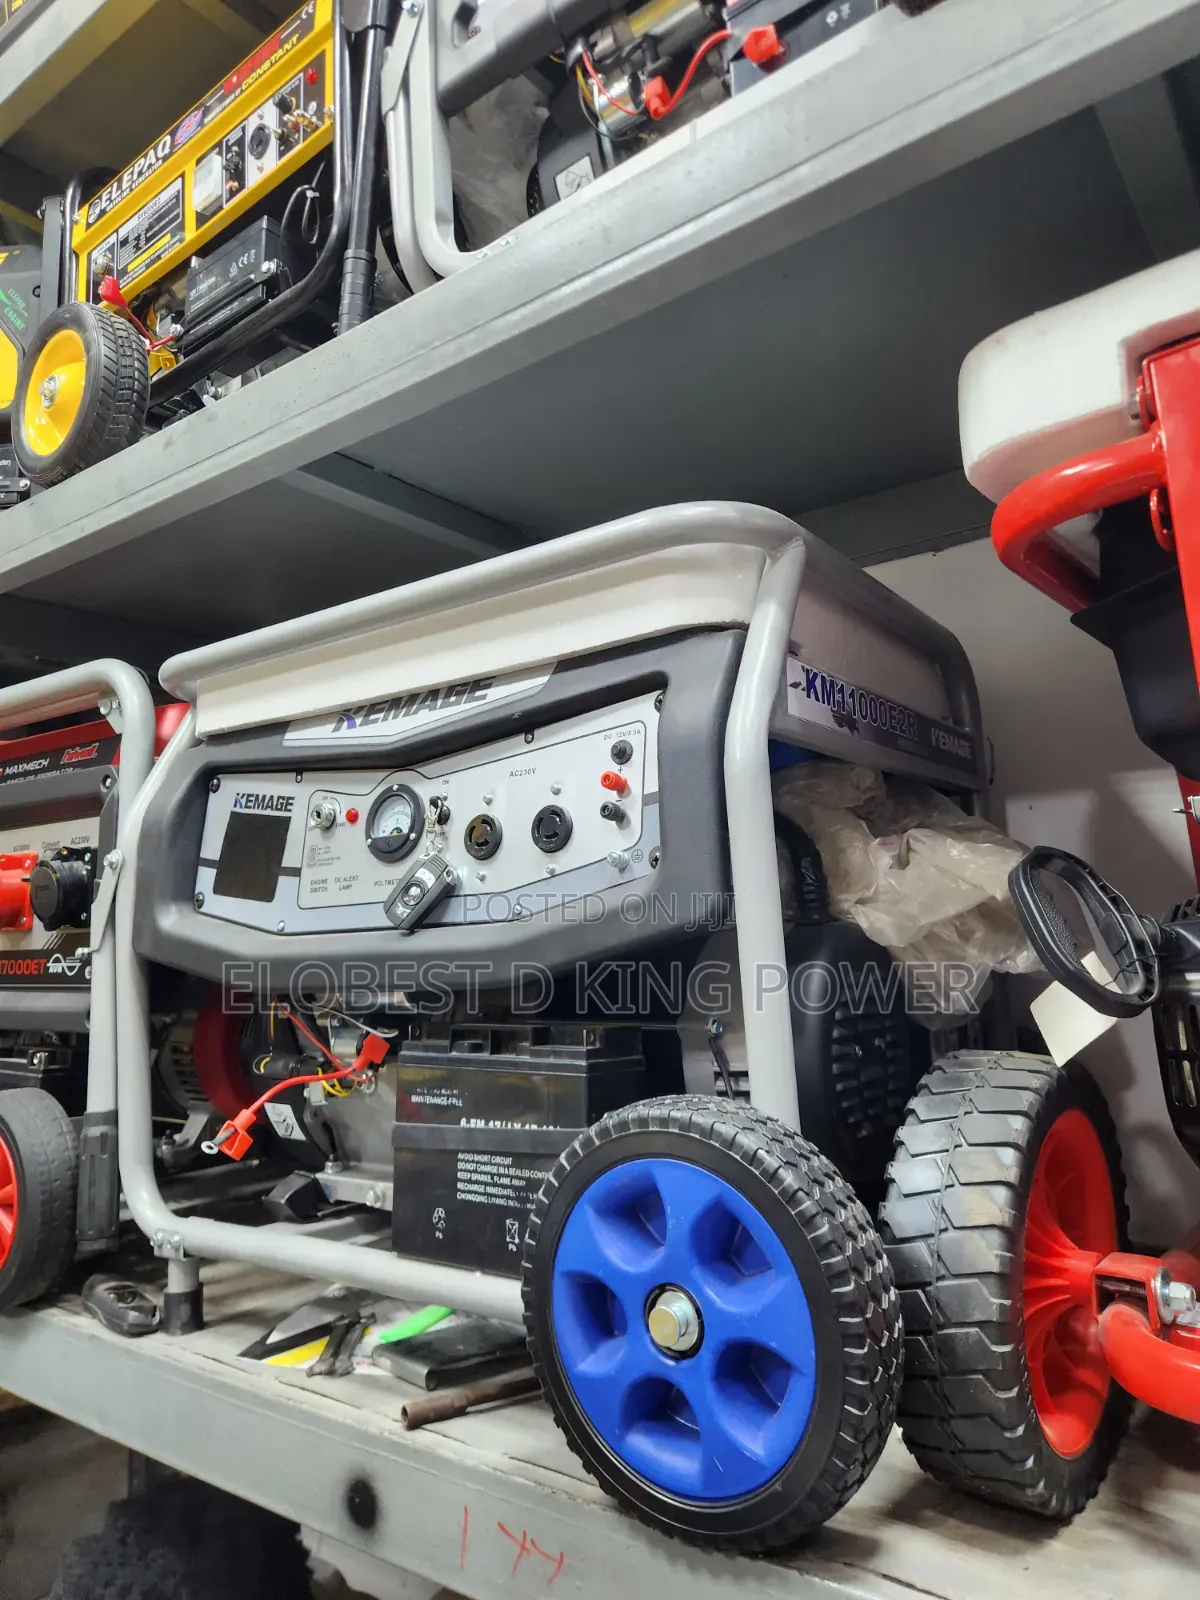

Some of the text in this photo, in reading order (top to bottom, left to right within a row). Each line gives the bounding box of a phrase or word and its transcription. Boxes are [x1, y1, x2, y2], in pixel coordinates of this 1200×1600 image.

[241, 33, 300, 90] CONSTANT
[100, 134, 172, 210] ELEPAQ
[331, 676, 497, 733] KEMAGE
[804, 667, 919, 741] KM11000E2R
[4, 758, 50, 776] MAXMECH
[509, 767, 537, 778] AC230V
[233, 792, 295, 813] KEMAGE
[310, 878, 328, 886] ENGINE
[343, 875, 359, 883] ALERT
[310, 886, 328, 894] SWITCH
[0, 958, 47, 975] 7000ET
[458, 1152, 512, 1165] AVOID SHORT CIRCUIT
[457, 1162, 465, 1170] DO
[466, 1162, 476, 1171] NOT
[476, 1163, 498, 1173] CHARGE
[499, 1166, 504, 1174] IN
[505, 1167, 509, 1175] A
[509, 1168, 530, 1177] SEALED
[457, 1171, 471, 1179] KEEP
[494, 1175, 511, 1184] FLAME
[512, 1178, 526, 1186] AWAY
[457, 1181, 485, 1192] RECHARGE
[435, 1231, 443, 1239] Pb
[508, 1243, 517, 1252] Pb
